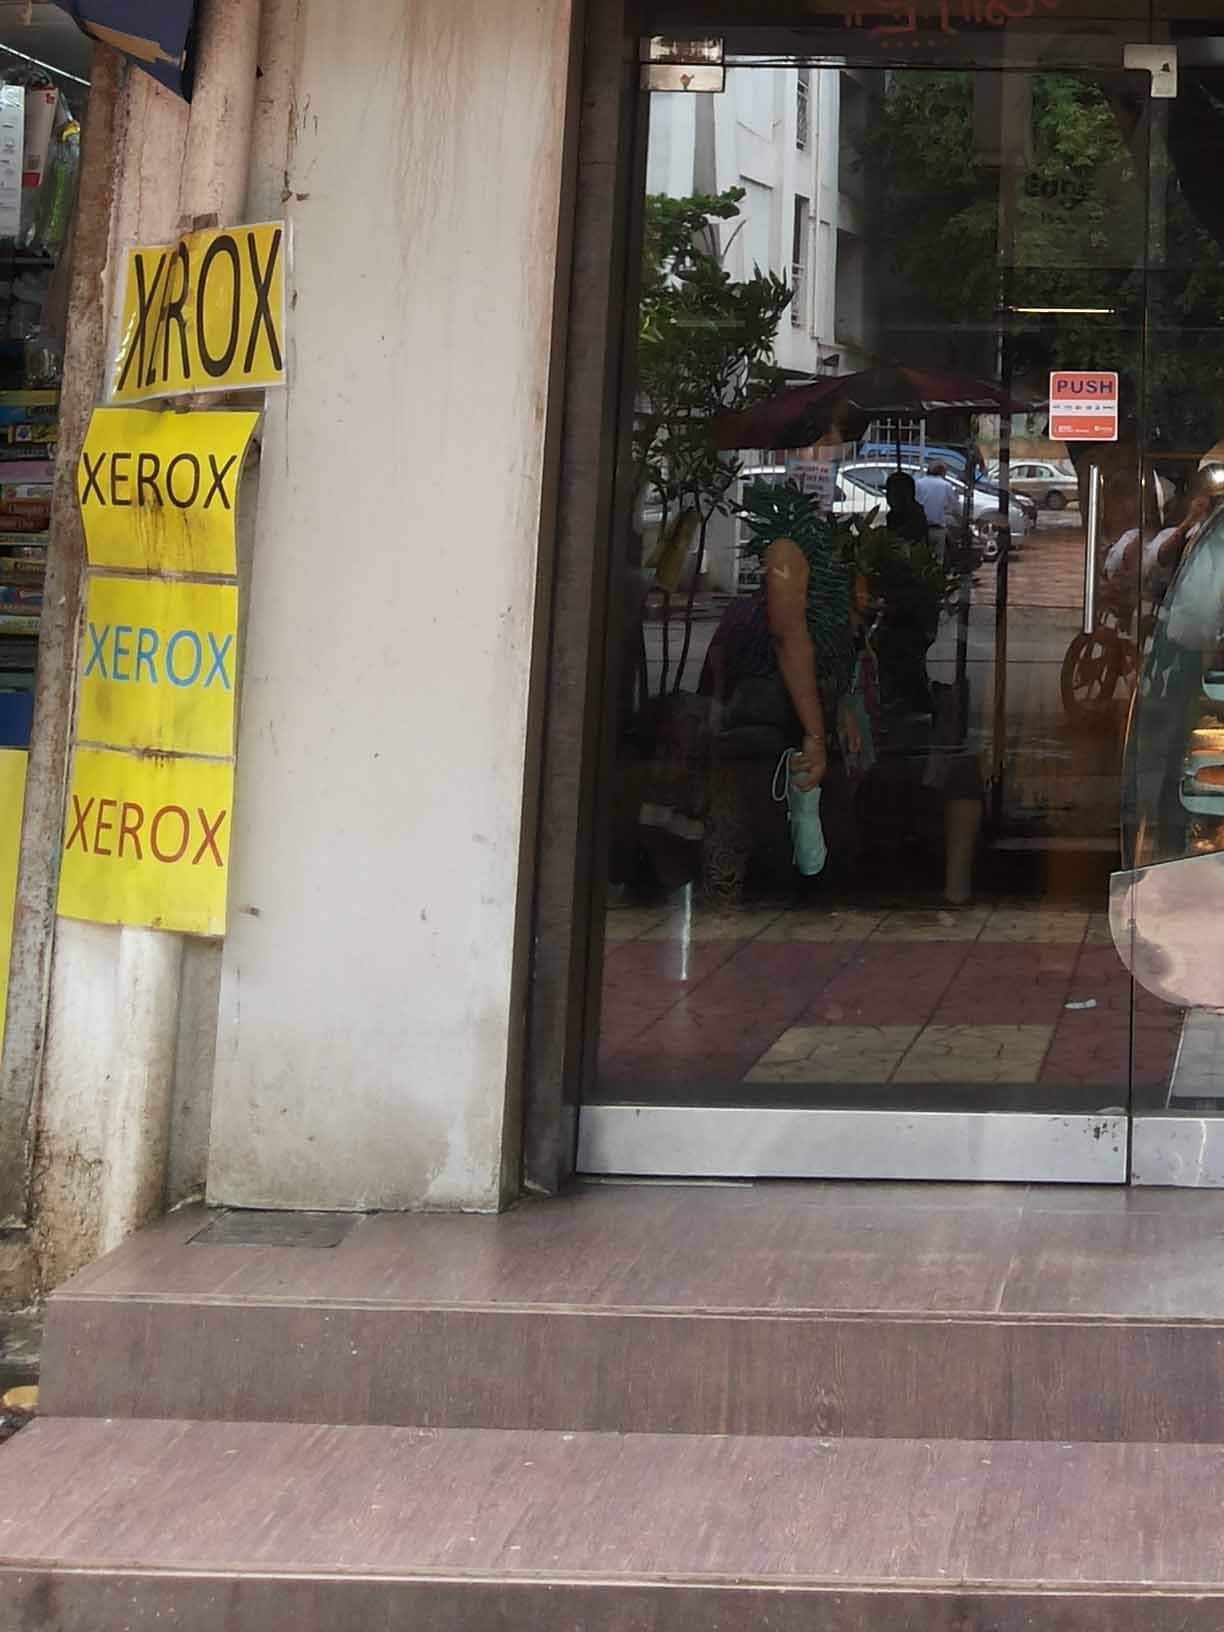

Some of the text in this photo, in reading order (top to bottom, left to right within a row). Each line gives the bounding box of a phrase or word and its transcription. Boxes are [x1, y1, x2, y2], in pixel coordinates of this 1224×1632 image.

[117, 228, 283, 392] XROX
[1056, 379, 1113, 394] PUSH
[80, 451, 238, 511] XEROX
[84, 621, 234, 691] XEROX
[64, 793, 228, 867] XEROX
